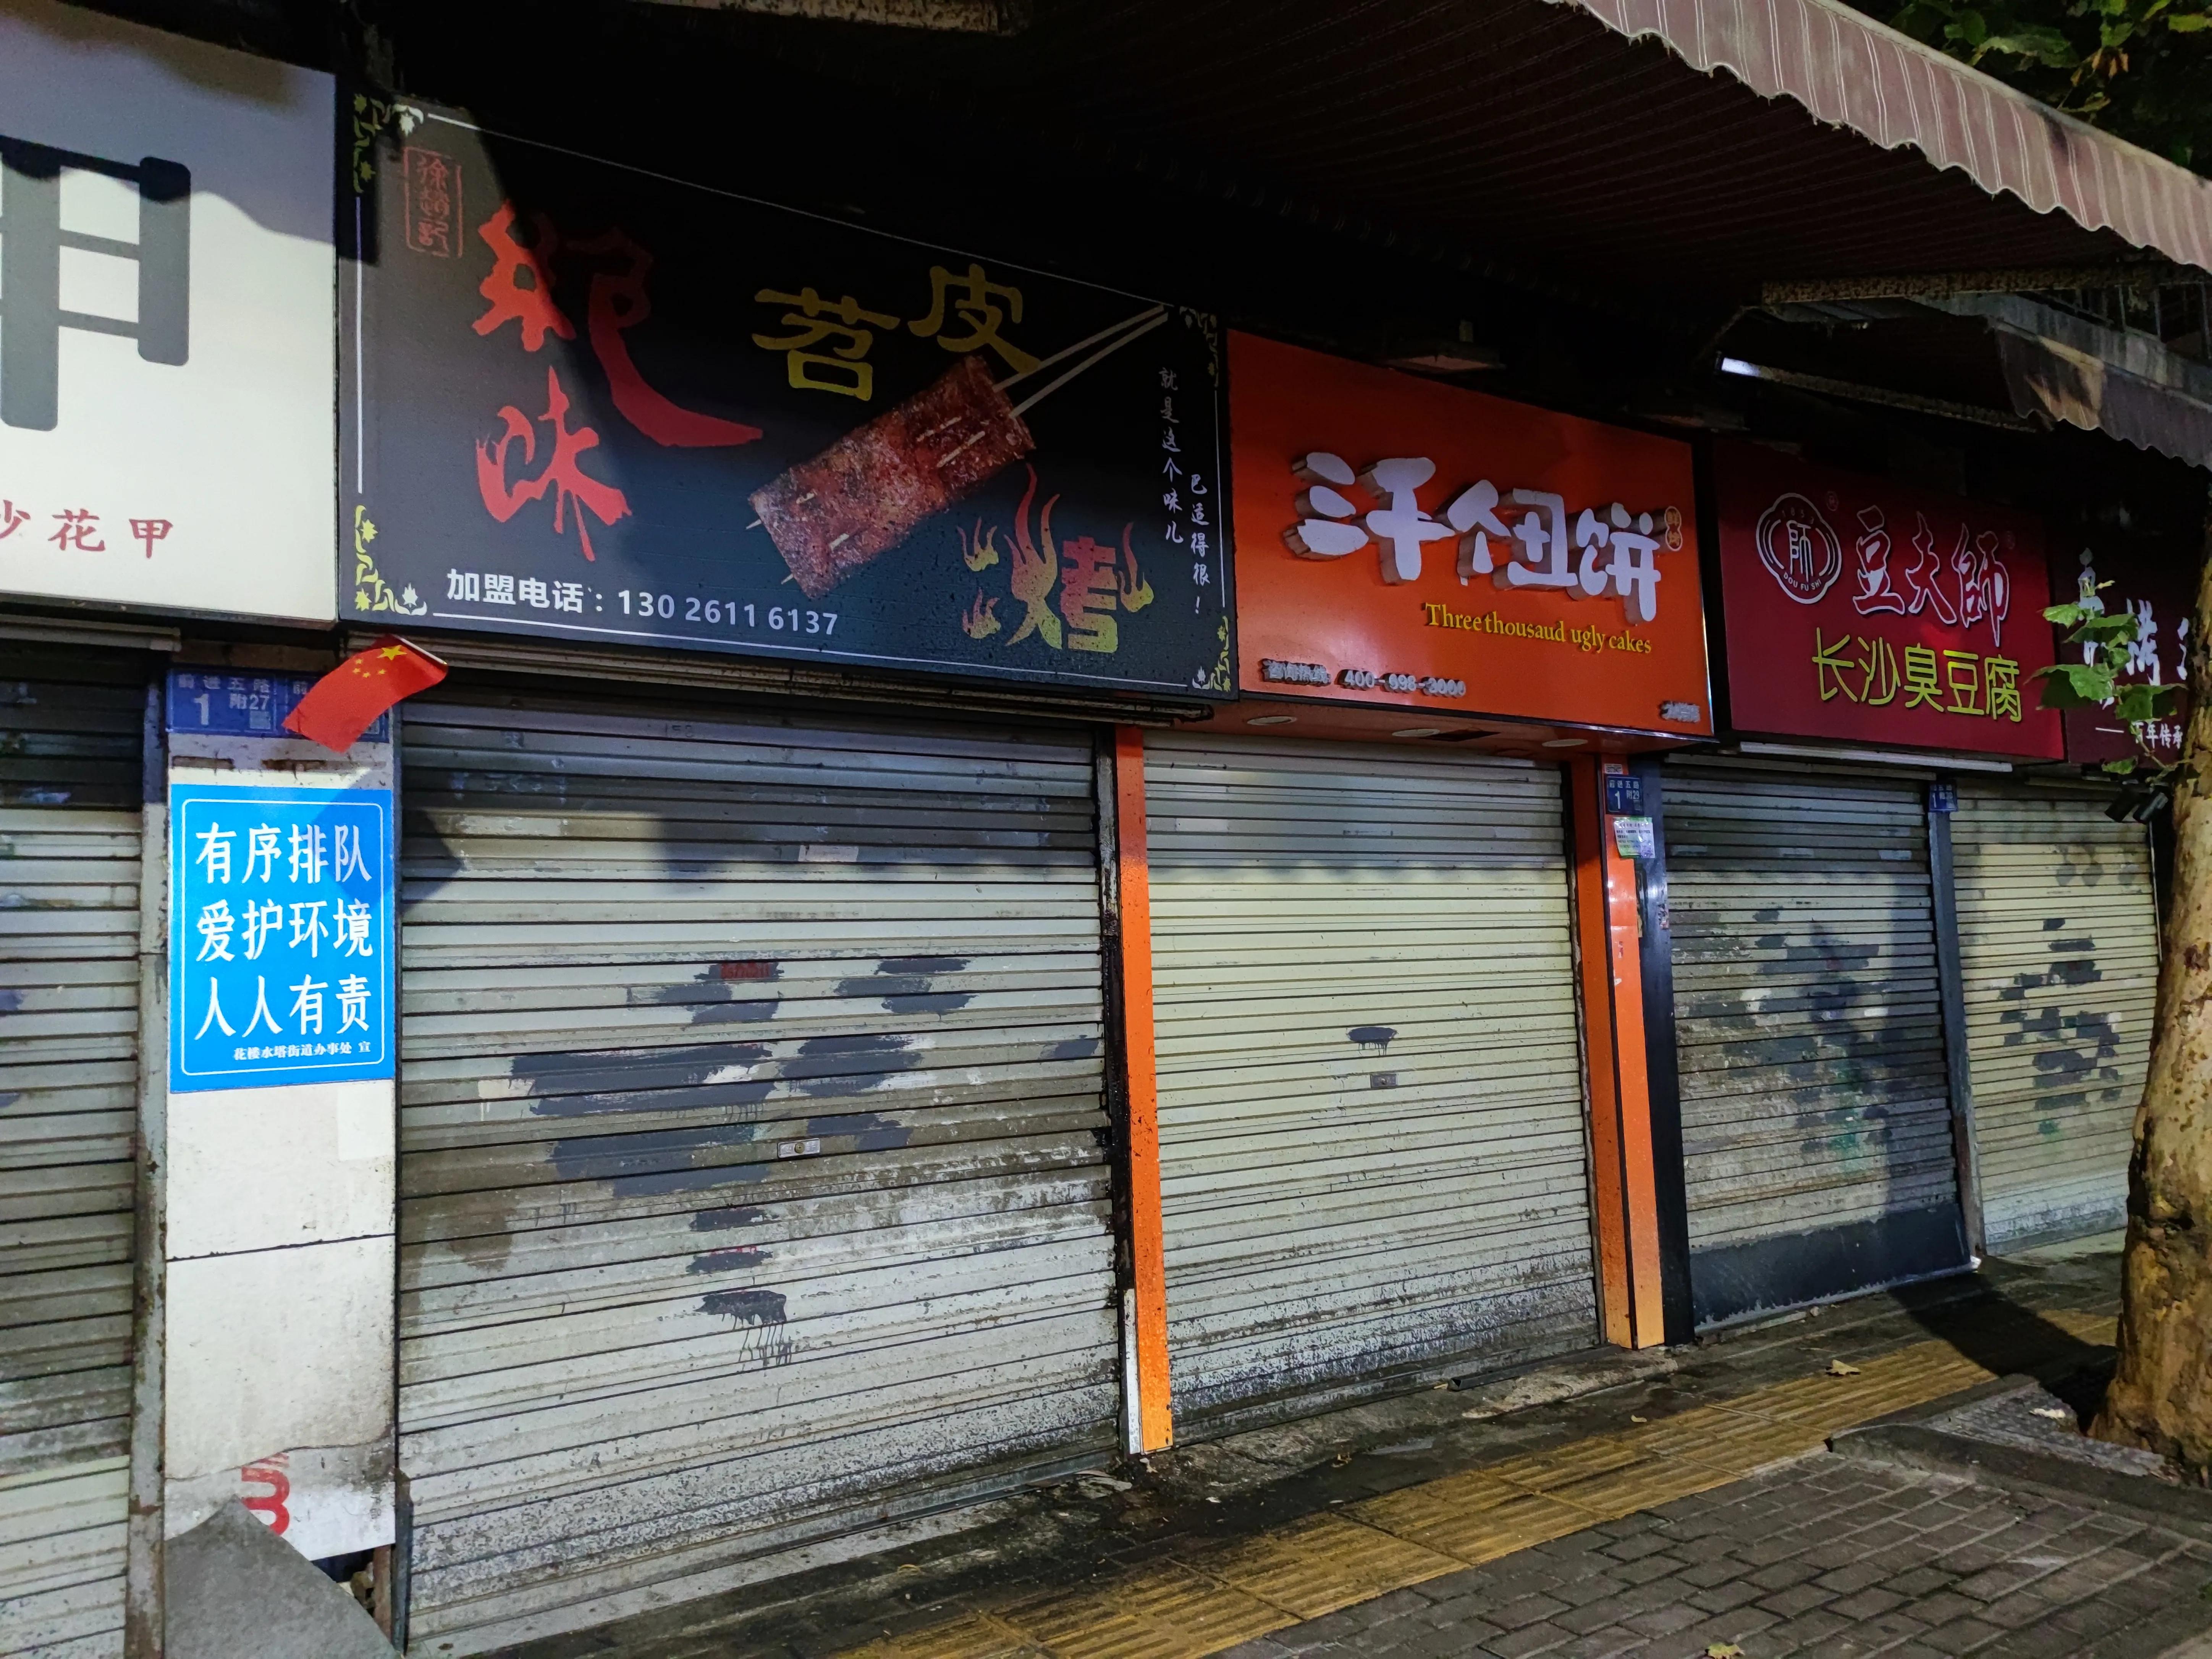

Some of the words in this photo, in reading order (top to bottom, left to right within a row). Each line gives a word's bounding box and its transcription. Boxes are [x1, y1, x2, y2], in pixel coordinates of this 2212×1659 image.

[752, 263, 1042, 402] 苕皮
[1158, 367, 1184, 544] 就是这个味儿
[1783, 572, 1798, 588] DOU
[1801, 583, 1809, 592] FU
[1811, 578, 1822, 590] SHI
[619, 590, 675, 619] 130
[685, 598, 755, 628] 2611
[768, 606, 838, 635] 6137
[1425, 603, 1482, 631] Three
[1570, 625, 1605, 653] ugly
[1609, 630, 1652, 653] cakes
[1812, 627, 2023, 723] 长沙臭豆腐
[194, 693, 209, 725] 1
[229, 693, 270, 710] 附27
[1614, 790, 1621, 809] 1
[1626, 789, 1640, 800] 附29
[195, 822, 372, 884] 有序排队
[196, 897, 374, 962] 爱护环境
[194, 974, 370, 1040] 人人有责
[234, 1042, 352, 1060] 花楼水塔街道办事处
[358, 1040, 371, 1053] 宣
